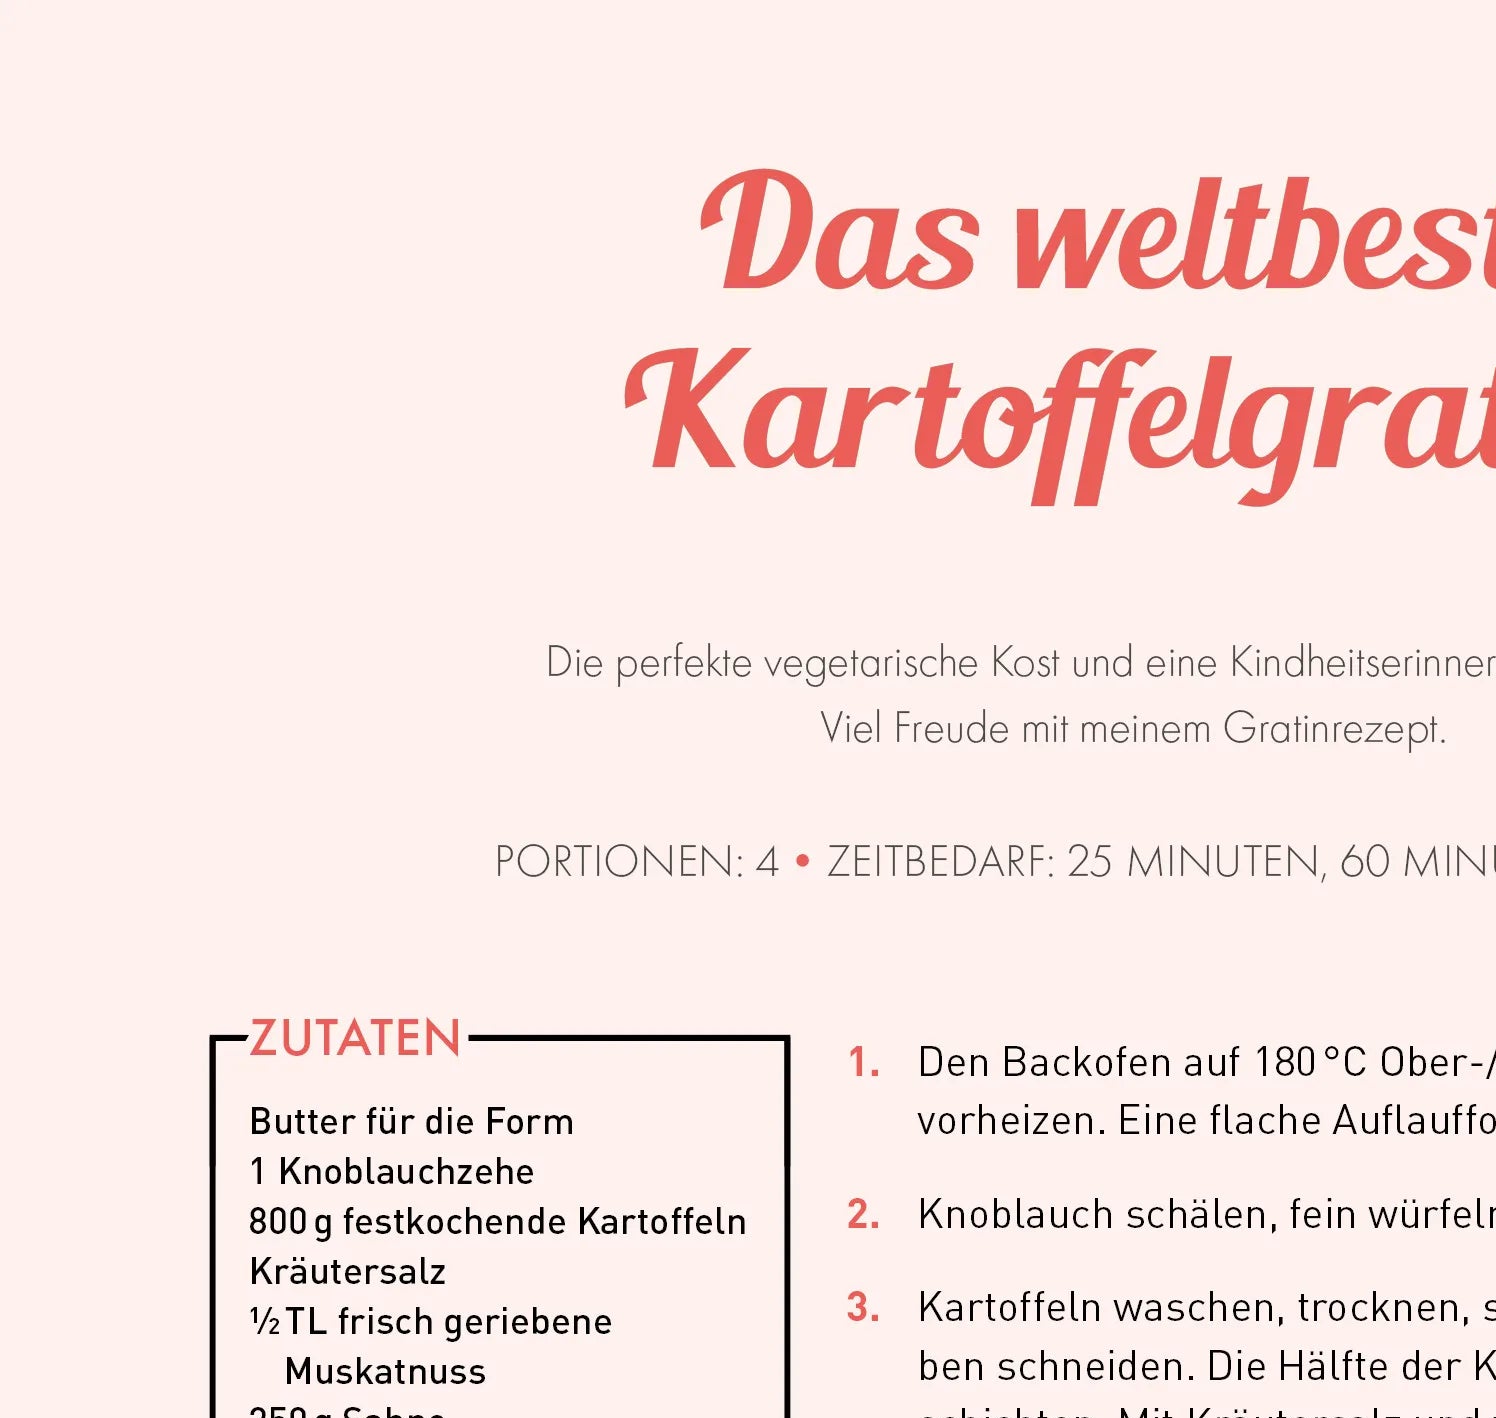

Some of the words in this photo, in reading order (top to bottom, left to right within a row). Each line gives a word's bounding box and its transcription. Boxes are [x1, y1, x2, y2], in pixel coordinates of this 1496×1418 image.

[699, 167, 980, 291] Das
[548, 644, 603, 678] Die
[617, 641, 752, 688] perfekte
[763, 642, 978, 688] vegetarische
[993, 644, 1061, 678] Kost
[1073, 642, 1132, 678] und
[1146, 648, 1217, 678] eine
[820, 708, 880, 744] Viel
[896, 708, 1009, 744] Freude
[1023, 714, 1069, 743] mit
[1081, 714, 1210, 744] meinem
[1223, 709, 1446, 754] Gratinrezept.
[497, 843, 743, 878] PORTIONEN:
[755, 844, 780, 877] 4
[827, 844, 1054, 878] ZEITBEDARF:
[1067, 843, 1112, 878] 25
[1128, 844, 1327, 884] MINUTEN,
[1340, 843, 1390, 878] 60
[249, 1016, 459, 1058] ZUTATEN
[849, 1045, 879, 1077] 1.
[920, 1045, 988, 1077] Den
[1004, 1045, 1170, 1077] Backofen
[1184, 1045, 1241, 1077] auf
[251, 1106, 357, 1135] Butter
[365, 1106, 416, 1135] für
[425, 1106, 474, 1135] die
[487, 1106, 573, 1135] Form
[916, 1103, 1105, 1135] vorheizen.
[1120, 1103, 1197, 1135] Eine
[1209, 1103, 1321, 1135] flache
[251, 1156, 262, 1185] 1
[280, 1156, 534, 1185] Knoblauchzehe
[249, 1206, 307, 1235] 800
[314, 1213, 332, 1243] g
[342, 1206, 566, 1235] festkochende
[579, 1206, 746, 1235] Kartoffeln
[847, 1197, 879, 1229] 2.
[920, 1197, 1112, 1229] Knoblauch
[1126, 1197, 1277, 1235] schälen,
[1289, 1197, 1355, 1229] fein
[251, 1256, 446, 1285] Kräutersalz
[284, 1306, 328, 1335] TL
[337, 1306, 433, 1336] frisch
[444, 1305, 612, 1343] geriebene
[847, 1290, 879, 1322] 3.
[920, 1290, 1100, 1322] Kartoffeln
[1112, 1290, 1284, 1328] waschen,
[1297, 1289, 1469, 1328] trocknen,
[286, 1356, 486, 1385] Muskatnuss
[920, 1349, 983, 1381] ben
[997, 1349, 1194, 1381] schneiden.
[1209, 1349, 1266, 1381] Die
[1280, 1349, 1388, 1381] Hälfte
[1402, 1349, 1463, 1381] der
